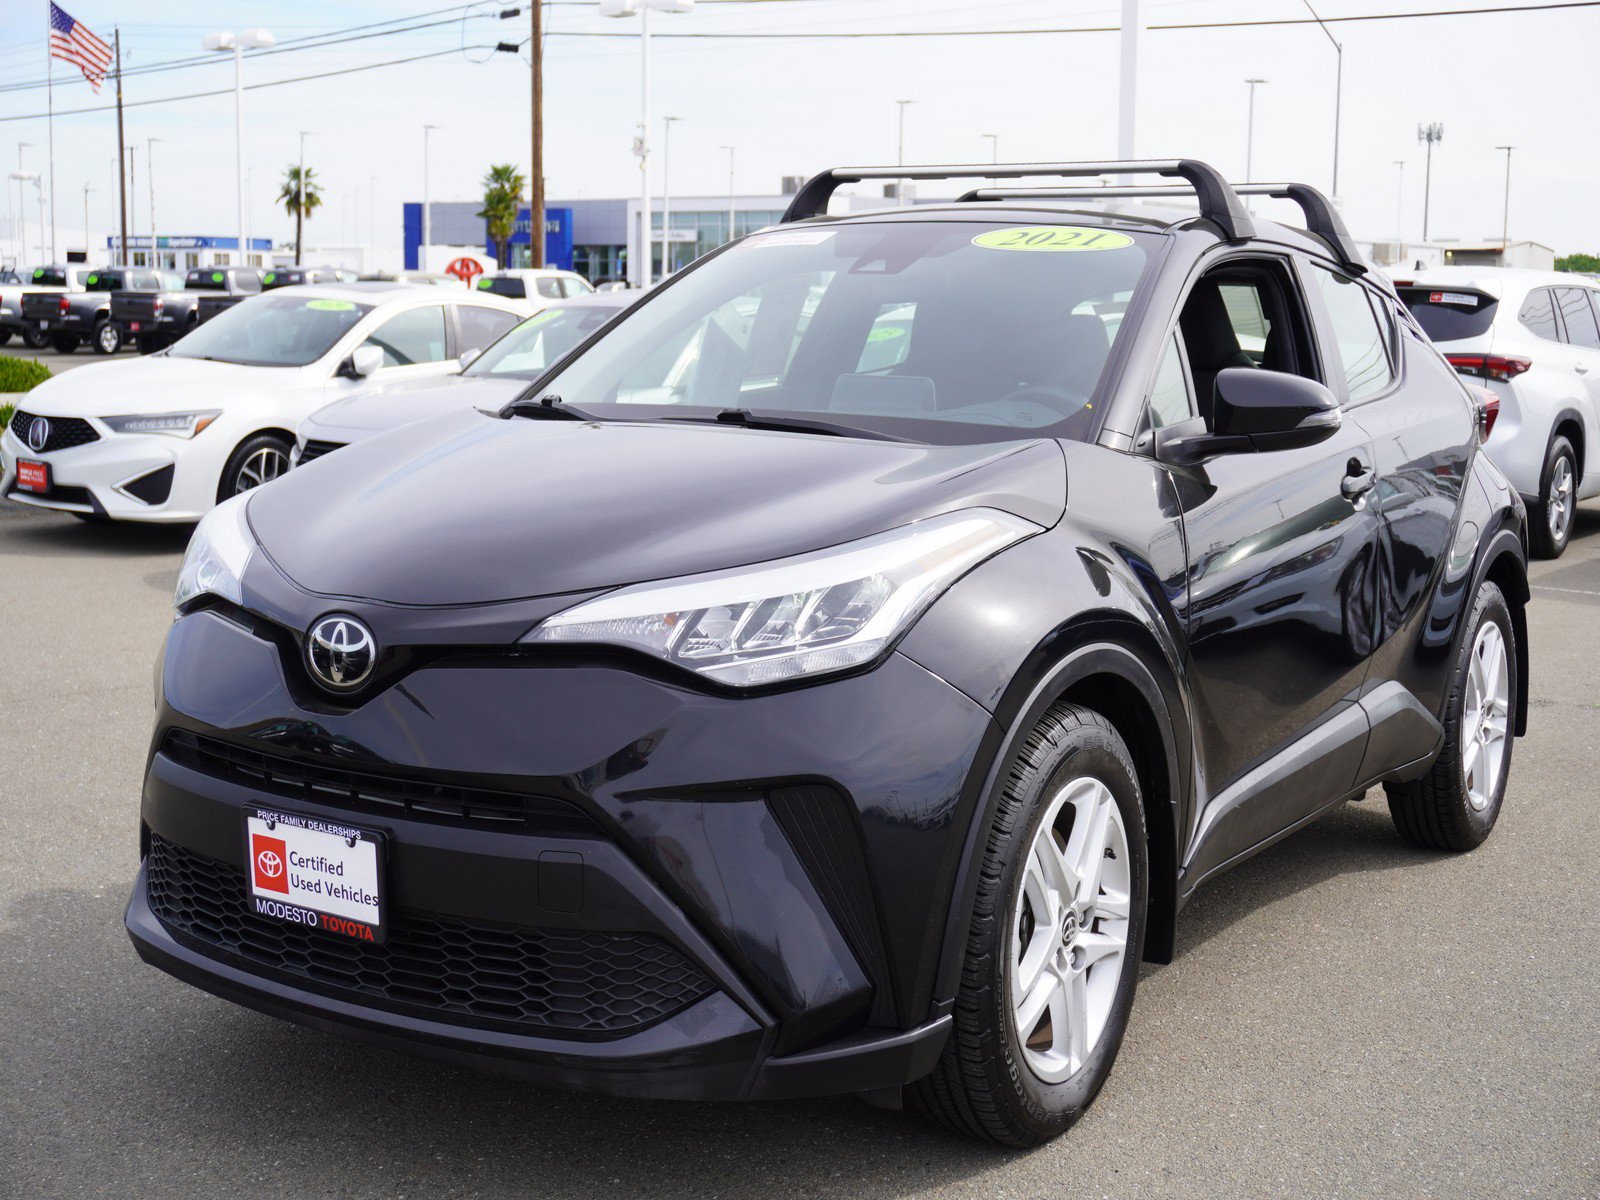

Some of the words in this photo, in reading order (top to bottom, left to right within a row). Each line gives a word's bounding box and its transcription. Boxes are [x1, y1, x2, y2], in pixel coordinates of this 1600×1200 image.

[996, 231, 1108, 246] 2021
[257, 810, 279, 823] PRICE
[280, 815, 307, 829] FAMILY
[308, 821, 362, 840] DEALERSHIPS
[289, 851, 344, 876] Certified
[290, 873, 322, 894] Used
[325, 881, 380, 907] Vehicles
[256, 899, 318, 927] MODESTO
[321, 915, 374, 941] TOYOTA
